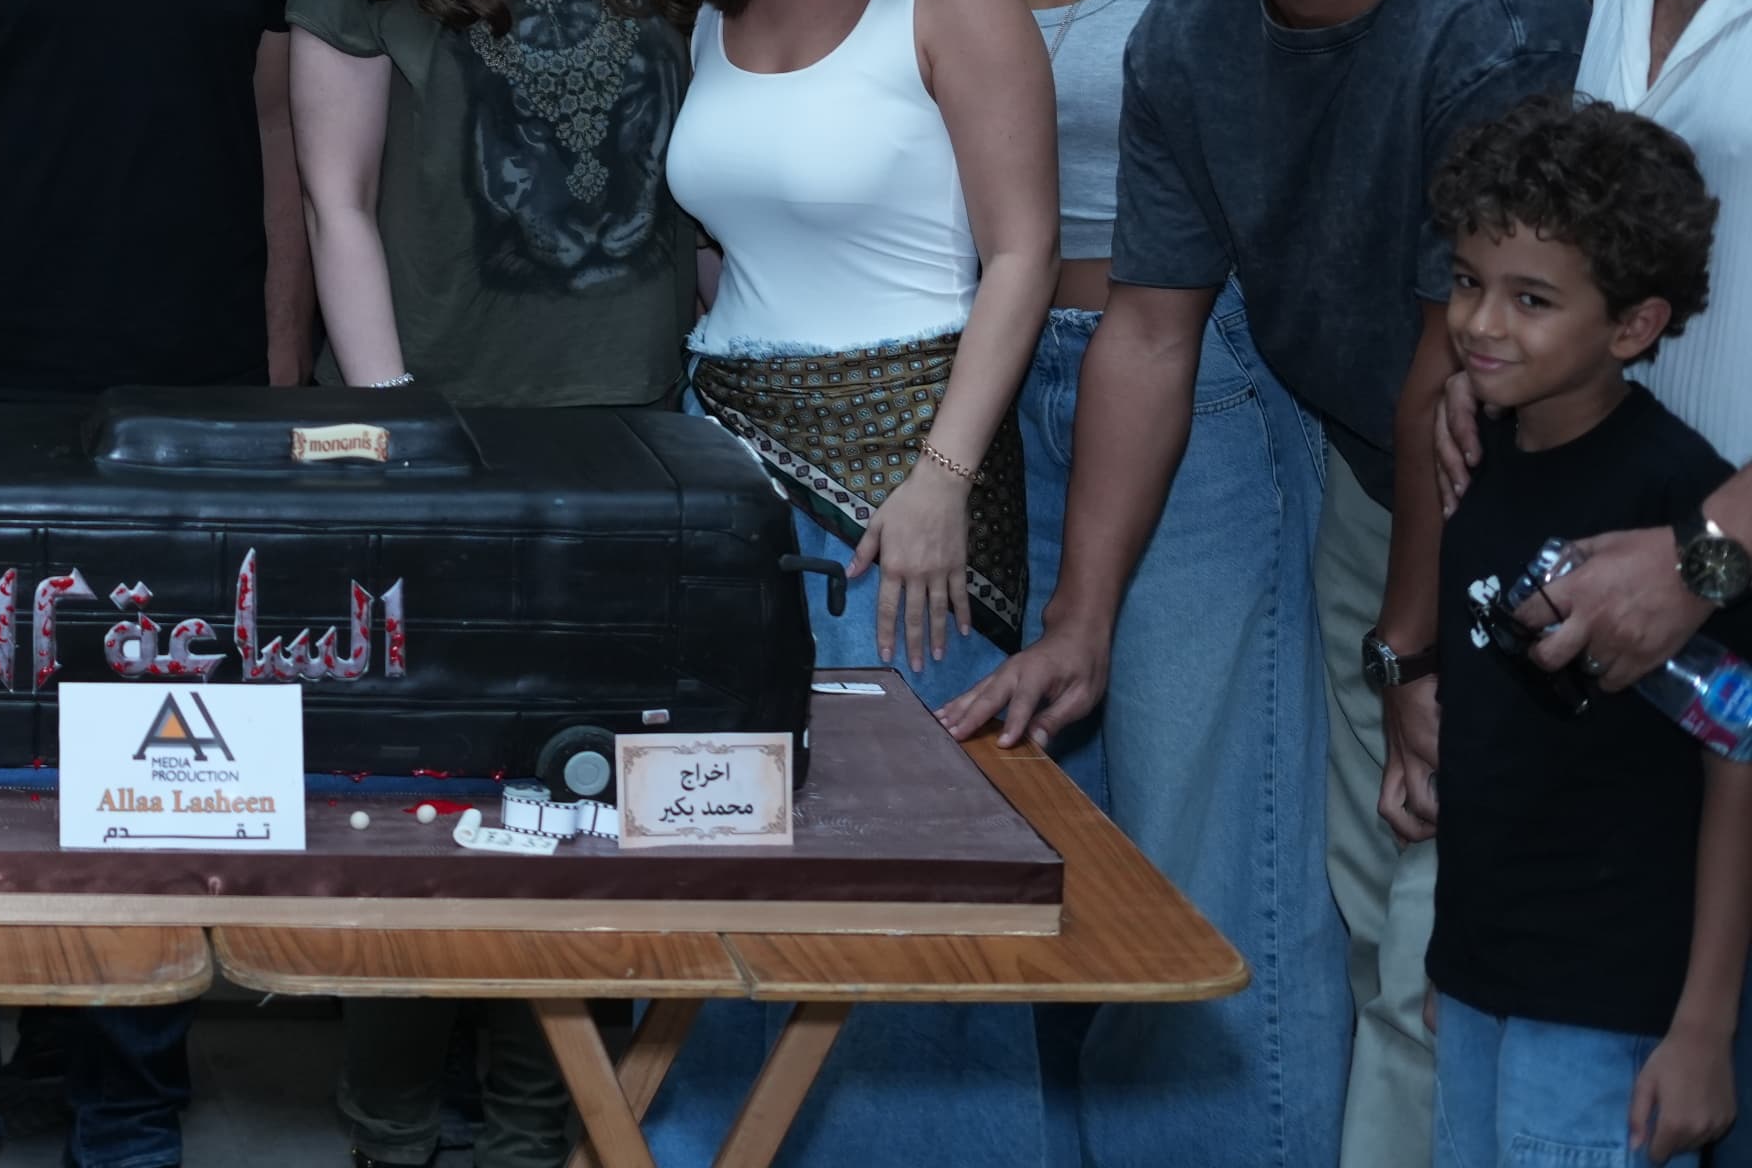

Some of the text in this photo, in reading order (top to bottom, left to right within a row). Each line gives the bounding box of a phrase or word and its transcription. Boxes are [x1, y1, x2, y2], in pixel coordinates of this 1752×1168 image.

[104, 547, 406, 683] الساعة
[151, 756, 192, 769] MEDIA
[151, 770, 240, 783] PRODUCTION
[680, 762, 731, 791] اخراج
[97, 788, 277, 814] Allaa Lasheen
[658, 796, 754, 823] محمد بكير
